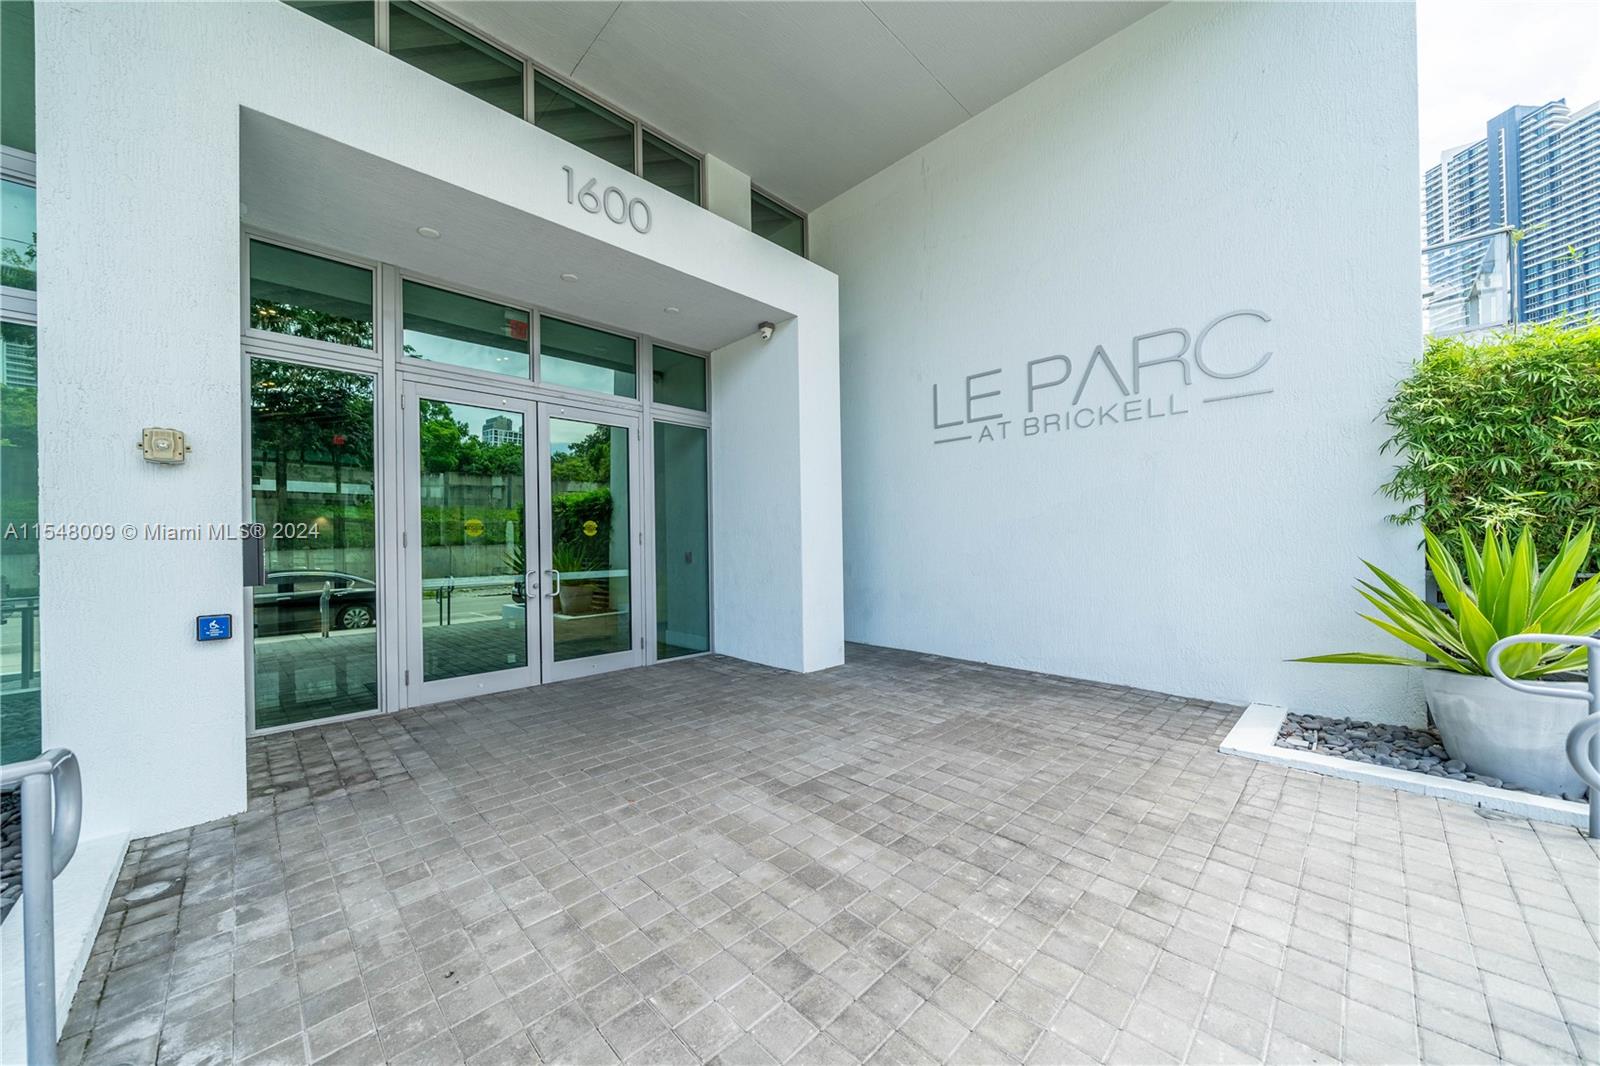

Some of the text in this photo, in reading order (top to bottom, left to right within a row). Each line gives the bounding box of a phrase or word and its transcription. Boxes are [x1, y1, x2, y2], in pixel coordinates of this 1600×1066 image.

[562, 165, 652, 234] 1600
[933, 309, 1273, 429] LE PARC
[978, 394, 1189, 443] AT BRICKELL
